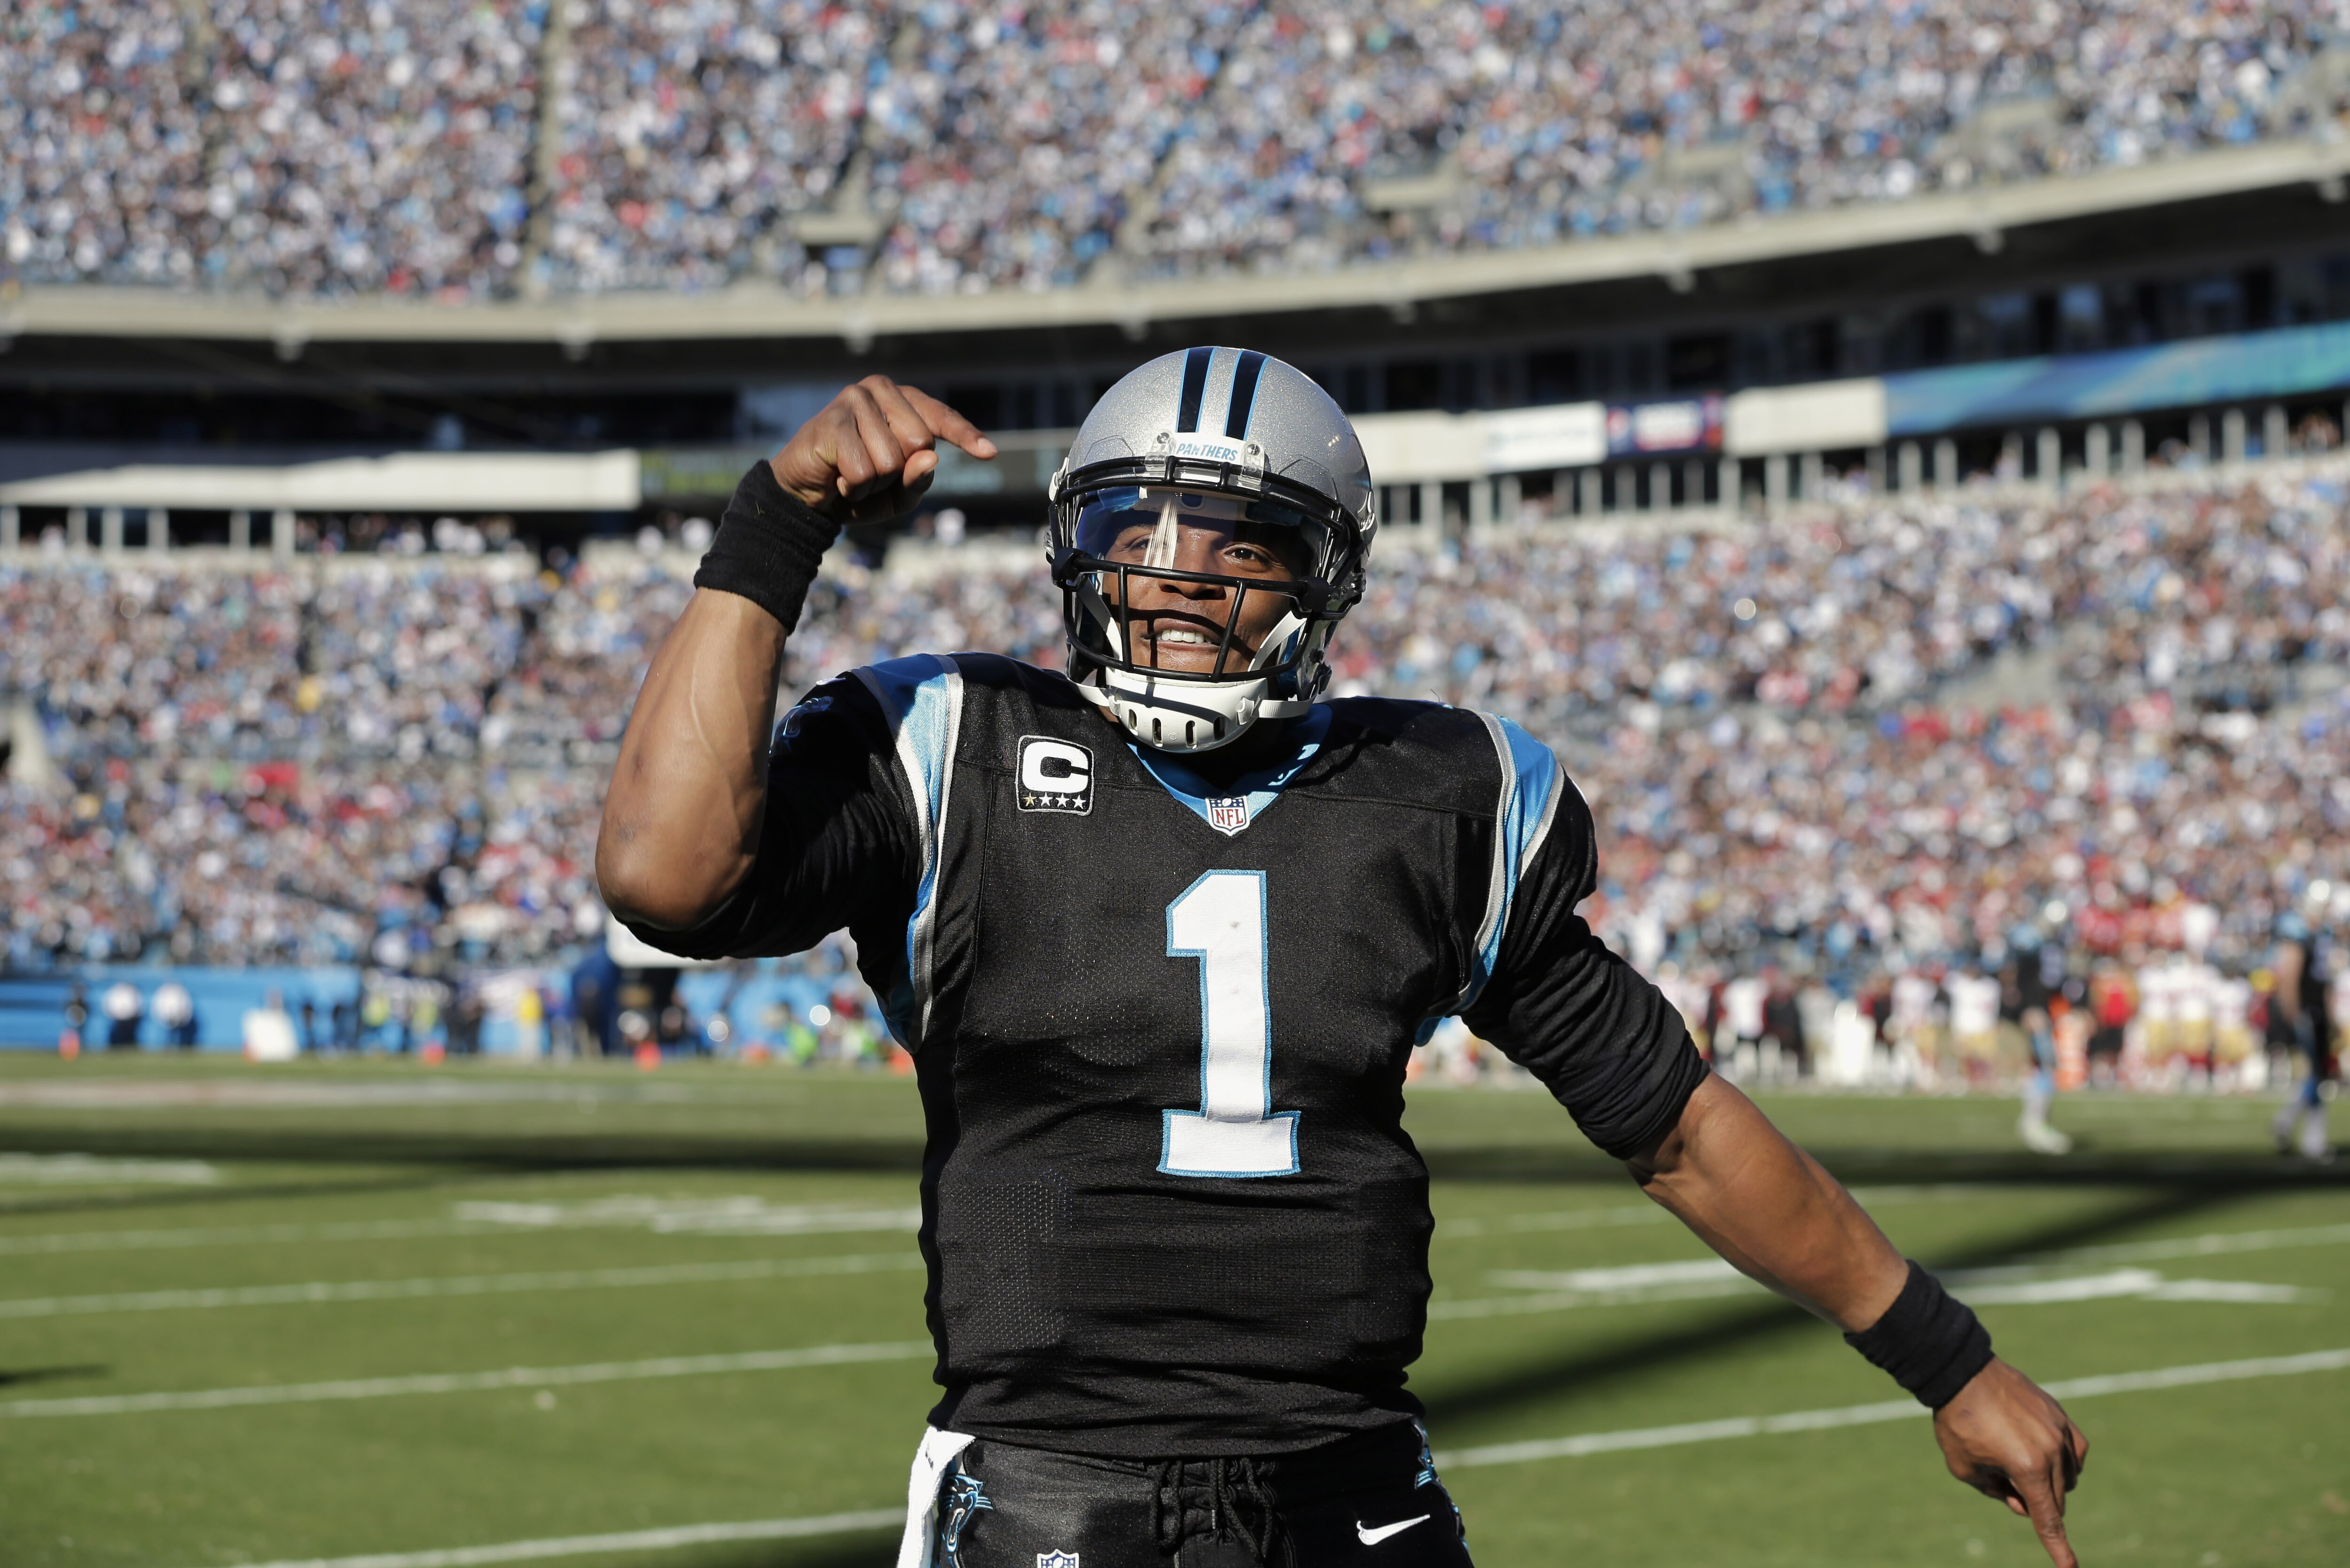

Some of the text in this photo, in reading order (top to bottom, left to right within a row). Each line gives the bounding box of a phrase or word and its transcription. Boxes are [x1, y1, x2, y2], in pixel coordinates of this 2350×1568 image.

[1176, 443, 1238, 461] PANTHERS
[1022, 741, 1089, 793] C
[1215, 809, 1244, 826] NFL
[1157, 869, 1301, 1178] 1
